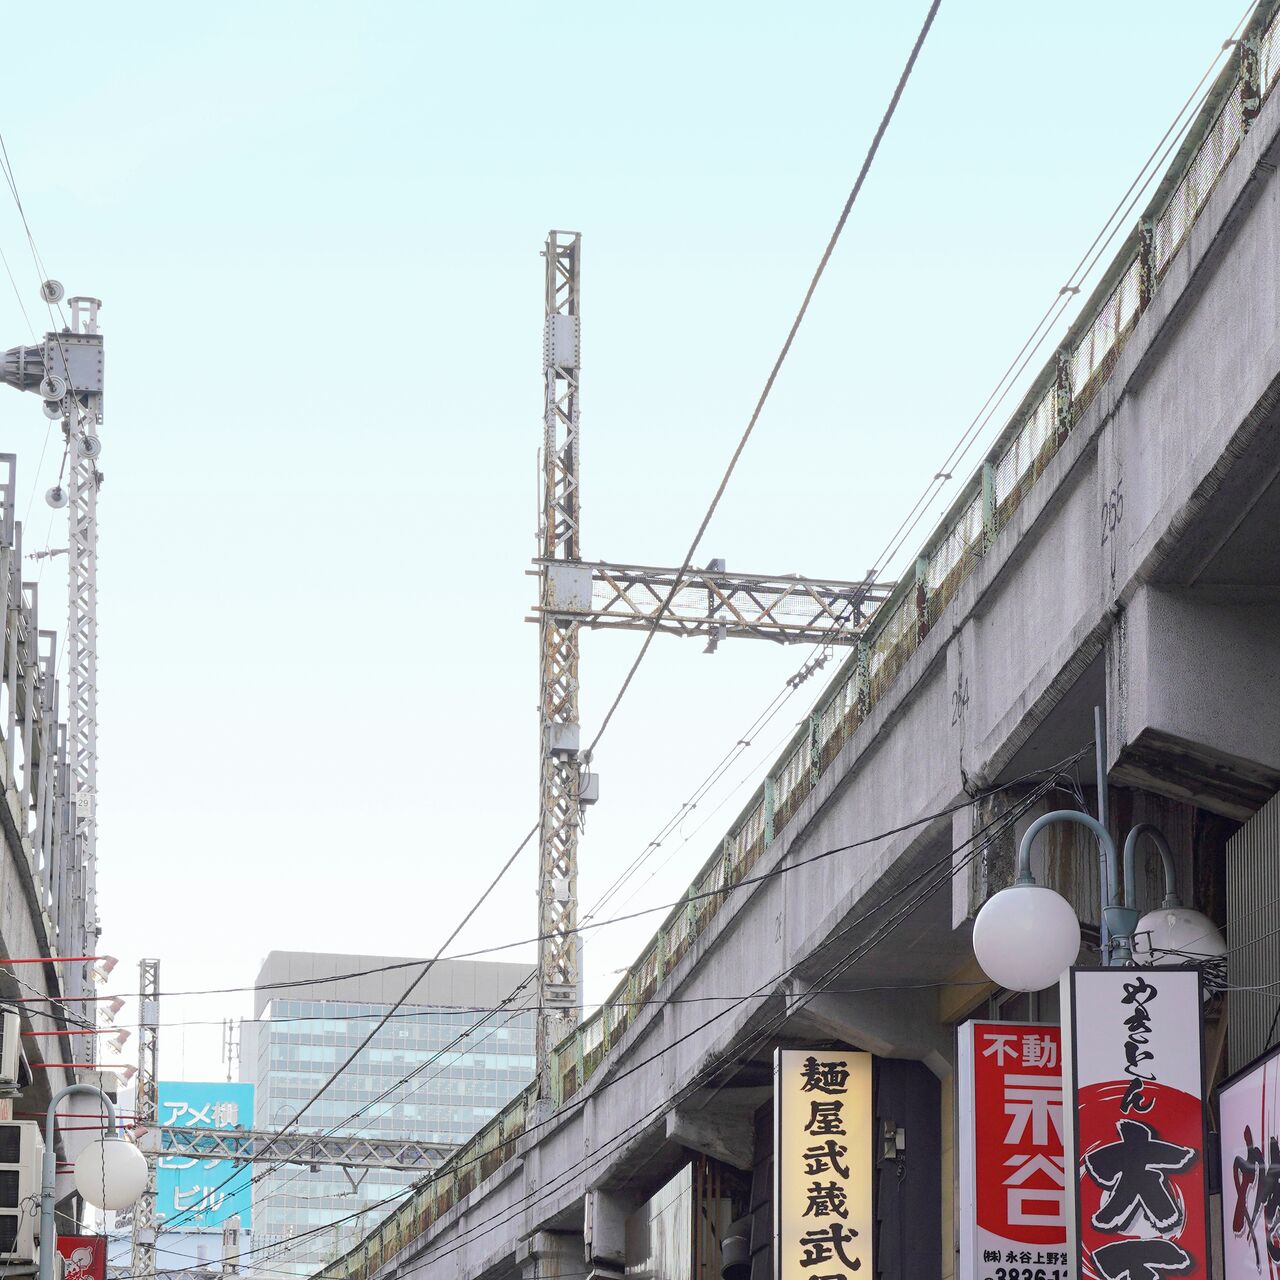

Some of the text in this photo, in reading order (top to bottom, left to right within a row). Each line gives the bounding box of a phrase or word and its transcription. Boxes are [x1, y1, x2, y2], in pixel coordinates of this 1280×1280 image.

[982, 1032, 1063, 1068] 不動
[1121, 976, 1158, 1115] やきとん
[163, 1101, 239, 1128] アメ横
[174, 1185, 225, 1212] ビル
